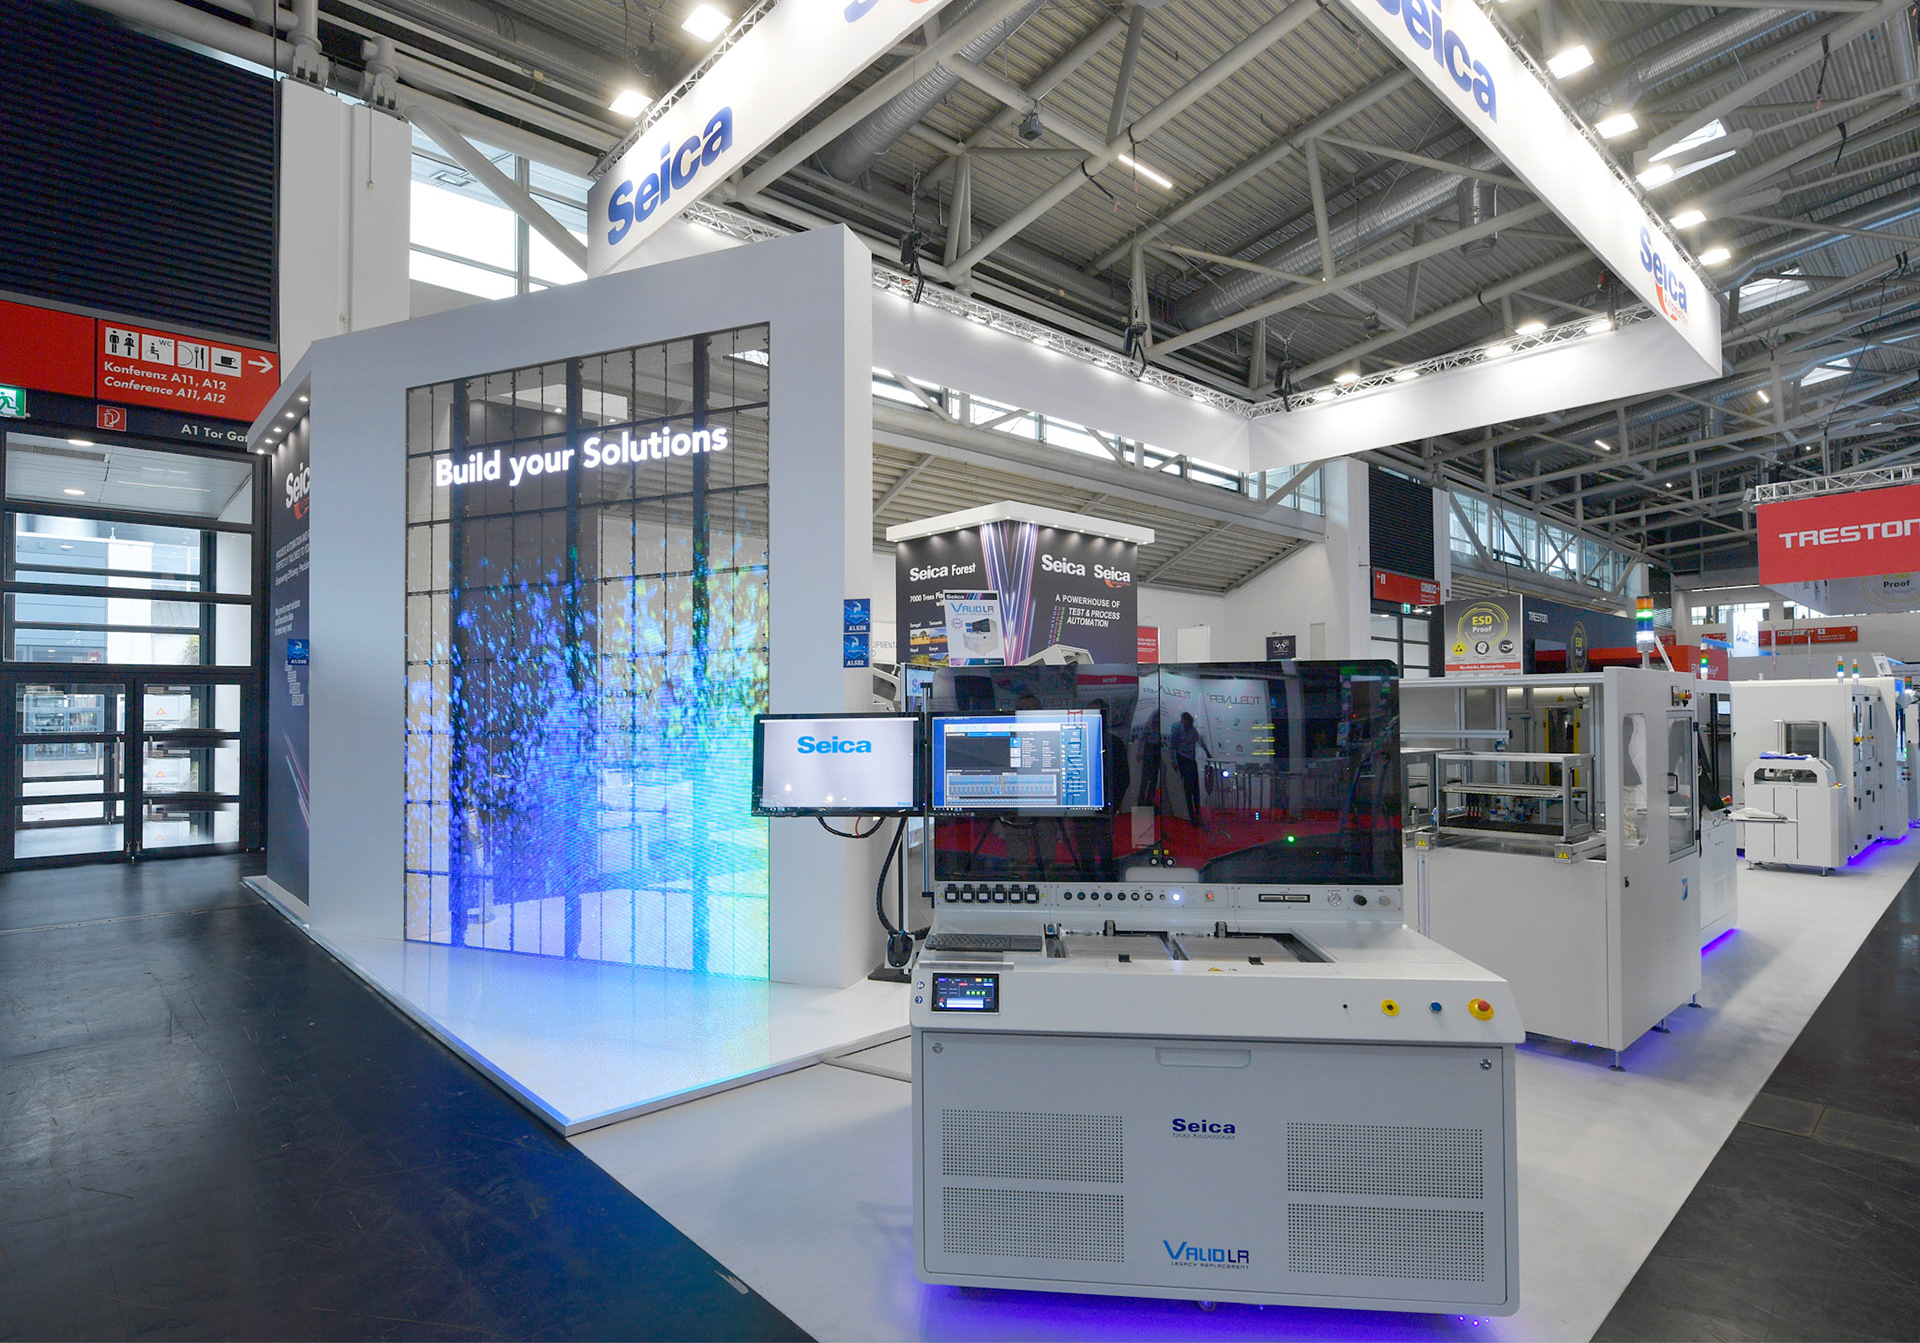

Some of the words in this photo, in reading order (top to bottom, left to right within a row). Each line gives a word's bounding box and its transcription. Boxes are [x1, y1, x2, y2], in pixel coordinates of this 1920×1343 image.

[607, 106, 734, 246] Seica
[1639, 225, 1688, 314] Seica
[158, 339, 173, 348] WC
[104, 361, 168, 382] Konferenz
[171, 372, 200, 388] A11,
[203, 379, 227, 391] A12
[104, 376, 174, 397] Conference
[176, 387, 202, 402] A11,
[203, 391, 227, 404] A12
[180, 424, 199, 437] A1
[203, 427, 224, 440] Tor
[436, 449, 500, 487] Build
[509, 447, 575, 487] your
[583, 426, 728, 468] Solutions
[285, 461, 309, 509] Seic
[909, 565, 949, 582] Seica
[951, 562, 976, 576] Forest
[1041, 554, 1086, 577] Seica
[1093, 563, 1131, 583] Seica
[1883, 580, 1911, 588] Proof
[909, 594, 922, 603] 7000
[922, 593, 935, 602] Trees
[1055, 593, 1061, 602] A
[1062, 594, 1110, 607] POWERHOUSE
[1111, 600, 1121, 608] OF
[1066, 616, 1109, 628] AUTOMATION
[1068, 607, 1085, 617] TEST
[1085, 609, 1091, 618] &
[1091, 609, 1121, 621] PROCESS
[1472, 615, 1493, 626] ESD
[1472, 625, 1493, 633] Proof
[796, 736, 873, 755] Seica
[1172, 1118, 1236, 1134] Seica
[1200, 1262, 1250, 1270] REPLACEMENT
